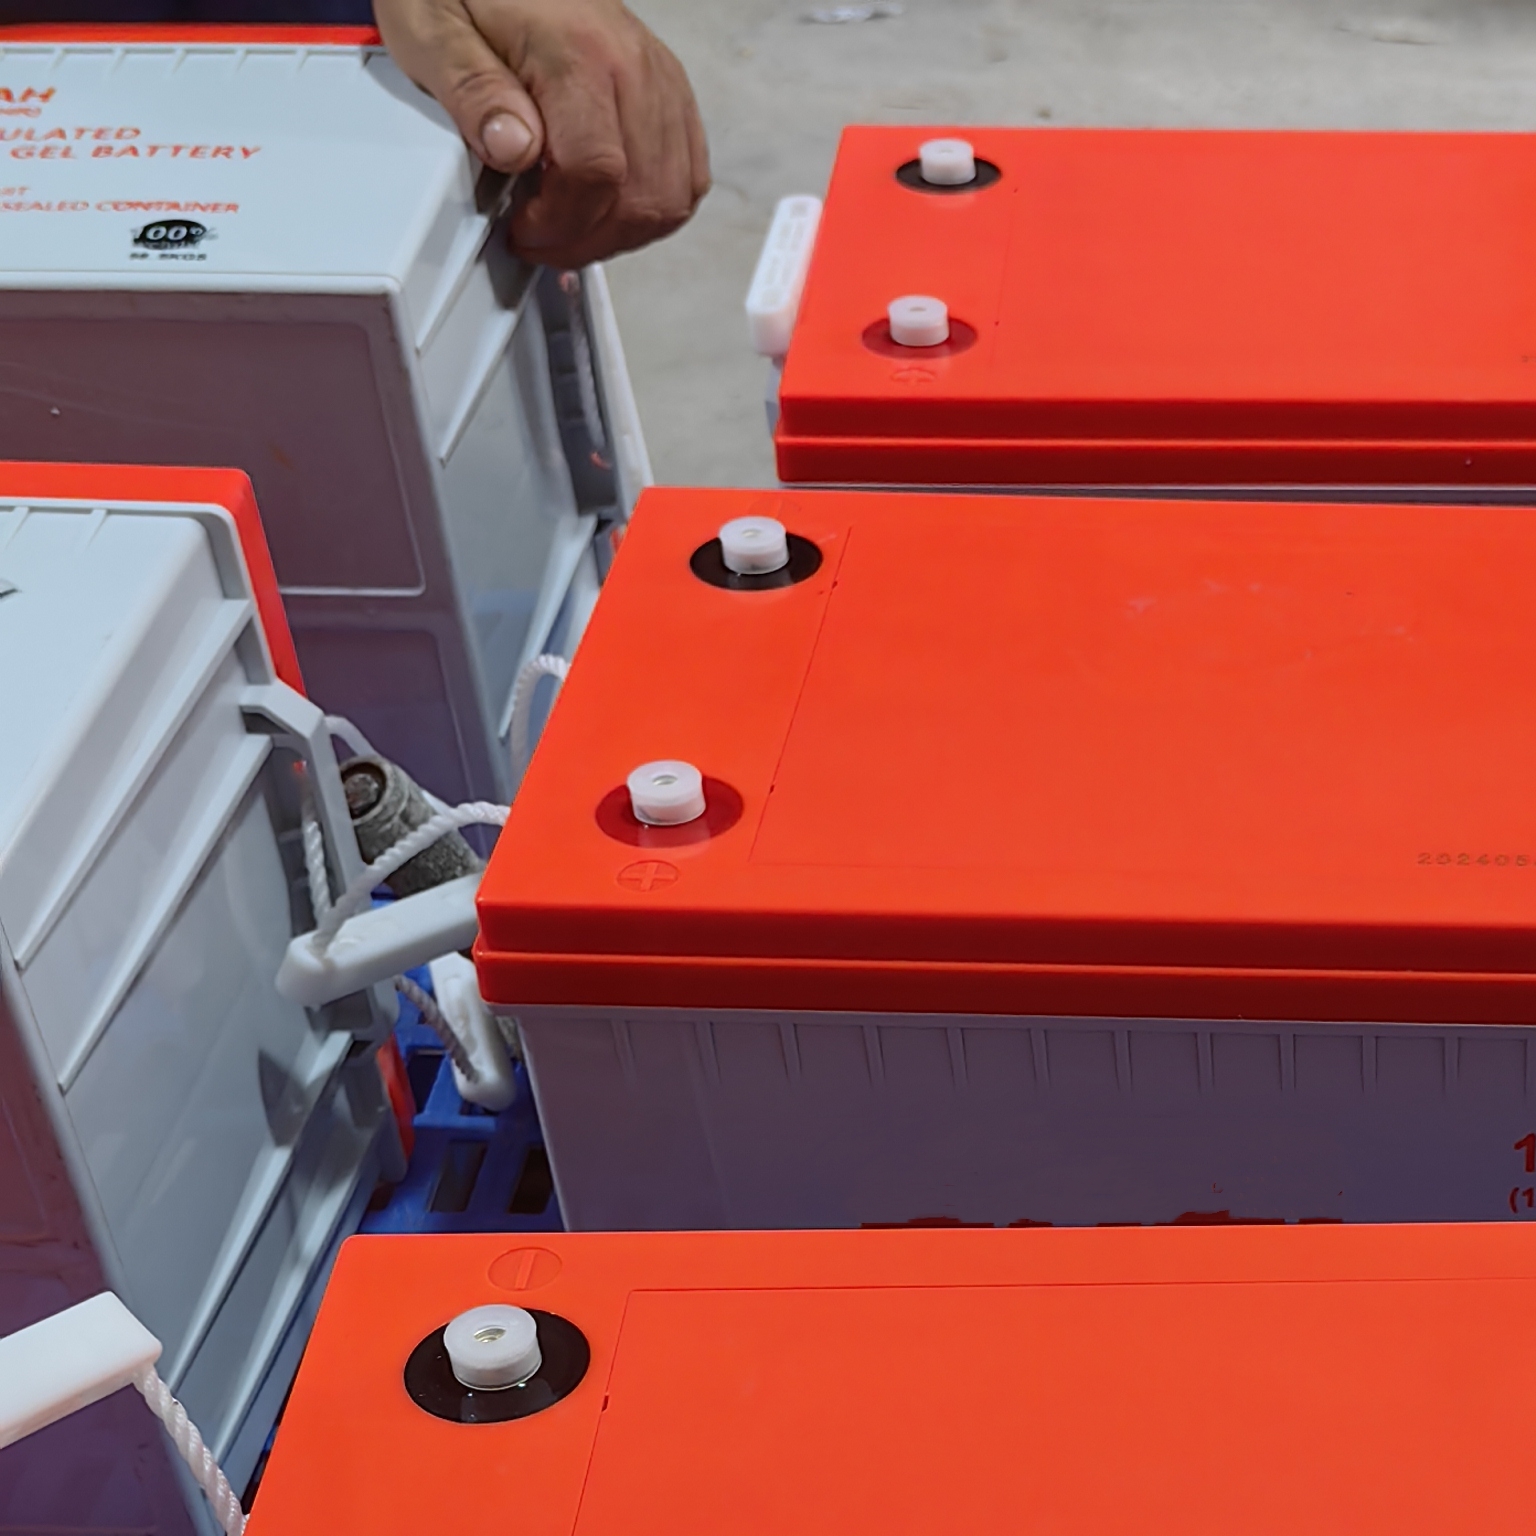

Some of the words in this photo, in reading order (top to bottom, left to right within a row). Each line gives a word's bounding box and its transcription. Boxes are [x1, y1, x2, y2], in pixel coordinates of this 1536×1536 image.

[0, 127, 141, 141] ULATED
[10, 145, 76, 159] GEL
[91, 145, 261, 159] BATTERY
